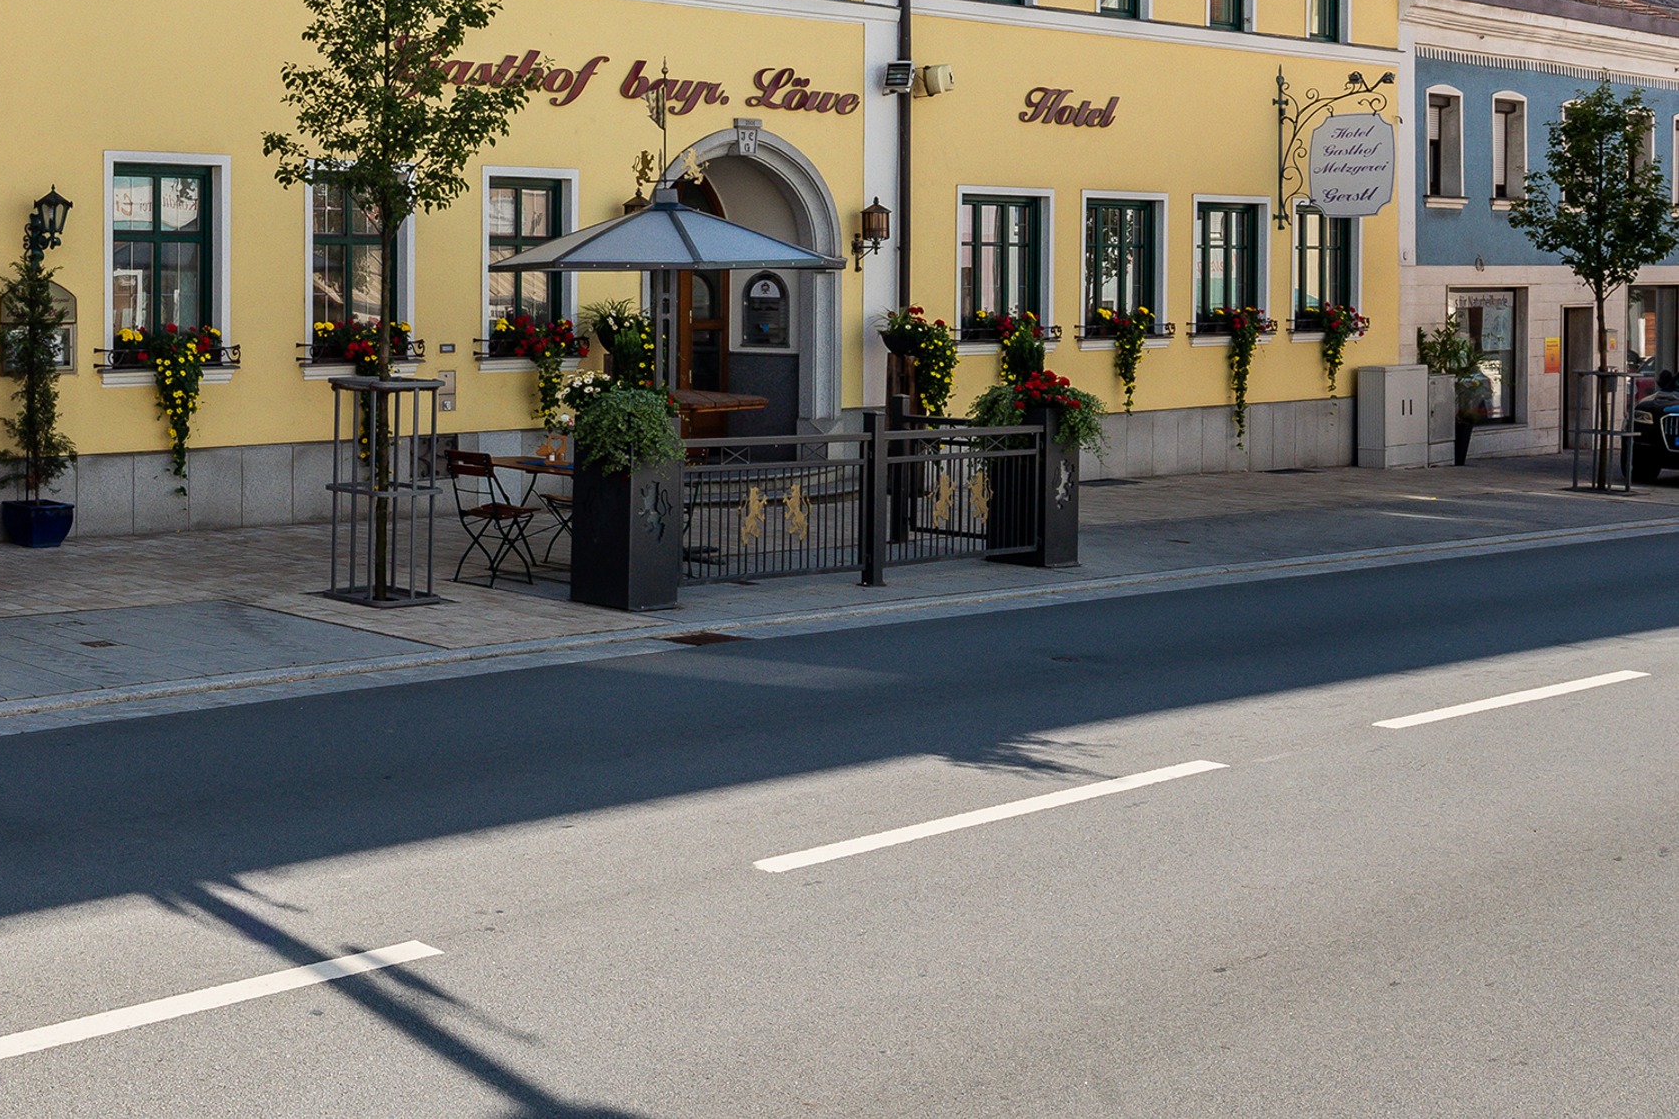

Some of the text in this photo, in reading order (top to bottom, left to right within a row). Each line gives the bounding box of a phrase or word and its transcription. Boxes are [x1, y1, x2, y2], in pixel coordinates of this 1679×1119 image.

[393, 34, 610, 107] asthof
[745, 68, 861, 116] Löwe
[1018, 86, 1121, 129] Hotel
[1331, 125, 1375, 139] Hotel
[1323, 142, 1382, 157] Gasthof
[1313, 161, 1389, 175] Metzgerei
[1322, 186, 1379, 203] Gerstl
